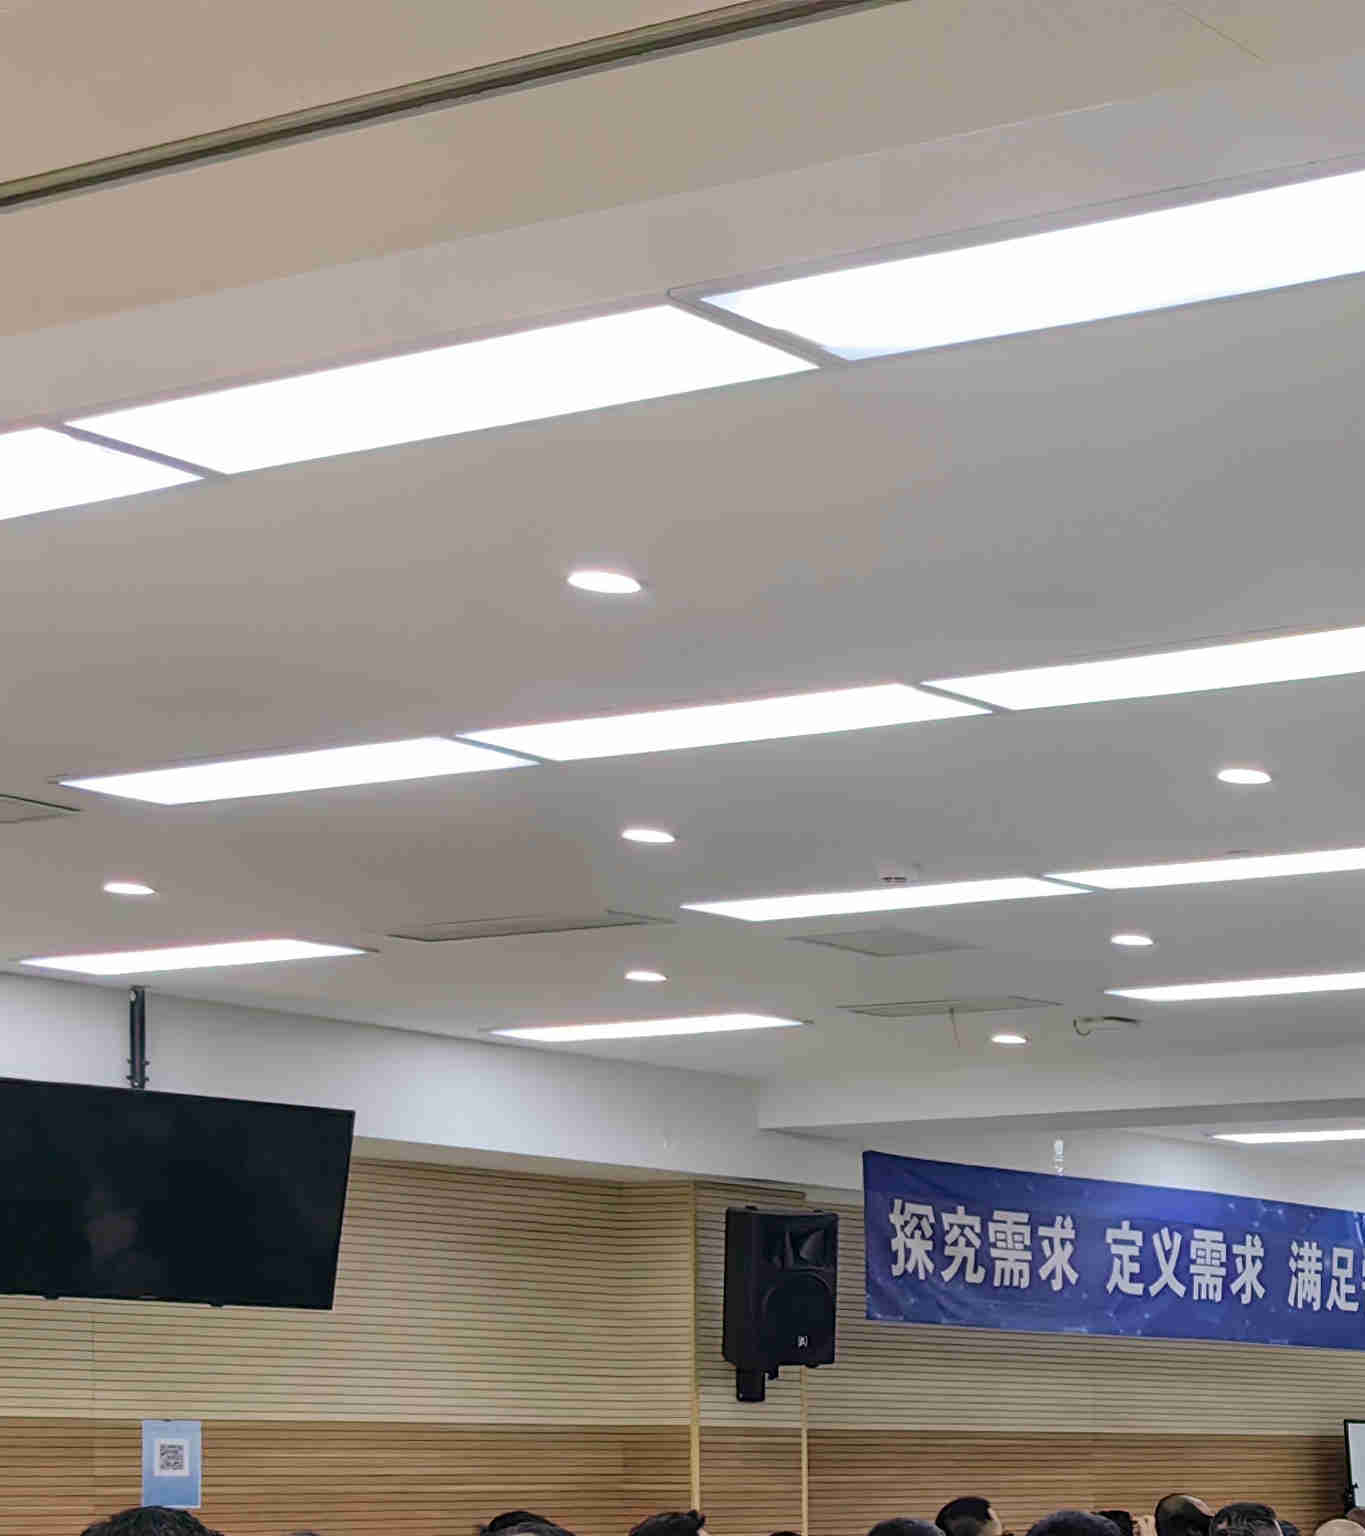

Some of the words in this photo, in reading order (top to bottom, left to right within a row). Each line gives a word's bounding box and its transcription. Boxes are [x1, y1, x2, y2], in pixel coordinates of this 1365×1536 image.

[889, 1199, 1078, 1291] 探究需求
[1105, 1221, 1265, 1304] 定义需求
